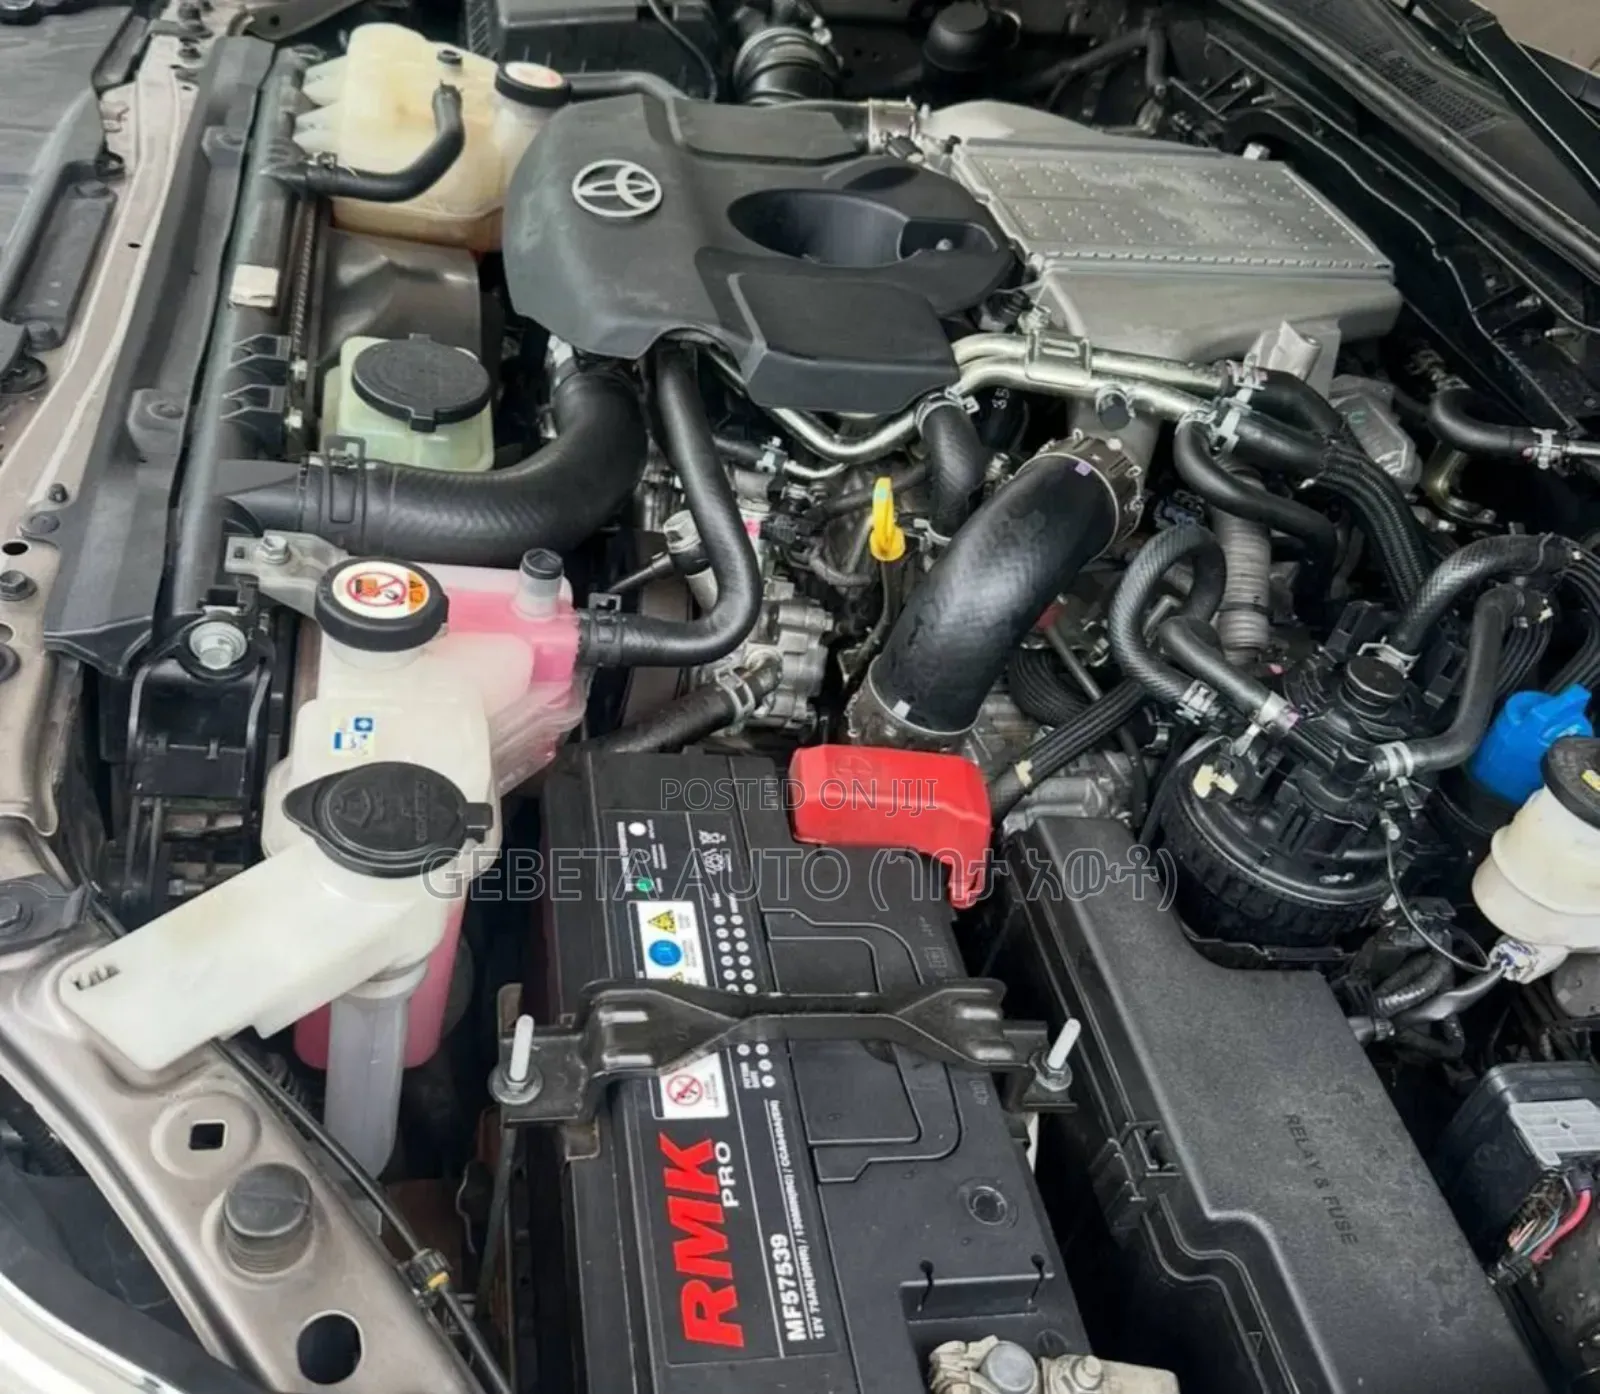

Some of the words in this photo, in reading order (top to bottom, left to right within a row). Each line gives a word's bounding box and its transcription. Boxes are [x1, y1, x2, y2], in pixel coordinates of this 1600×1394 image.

[714, 1141, 739, 1208] PRO
[1284, 1114, 1324, 1170] RELAY
[1314, 1177, 1329, 1189] &
[1322, 1196, 1359, 1245] FUSE
[658, 1131, 745, 1348] RMK
[769, 1233, 807, 1342] MF57539
